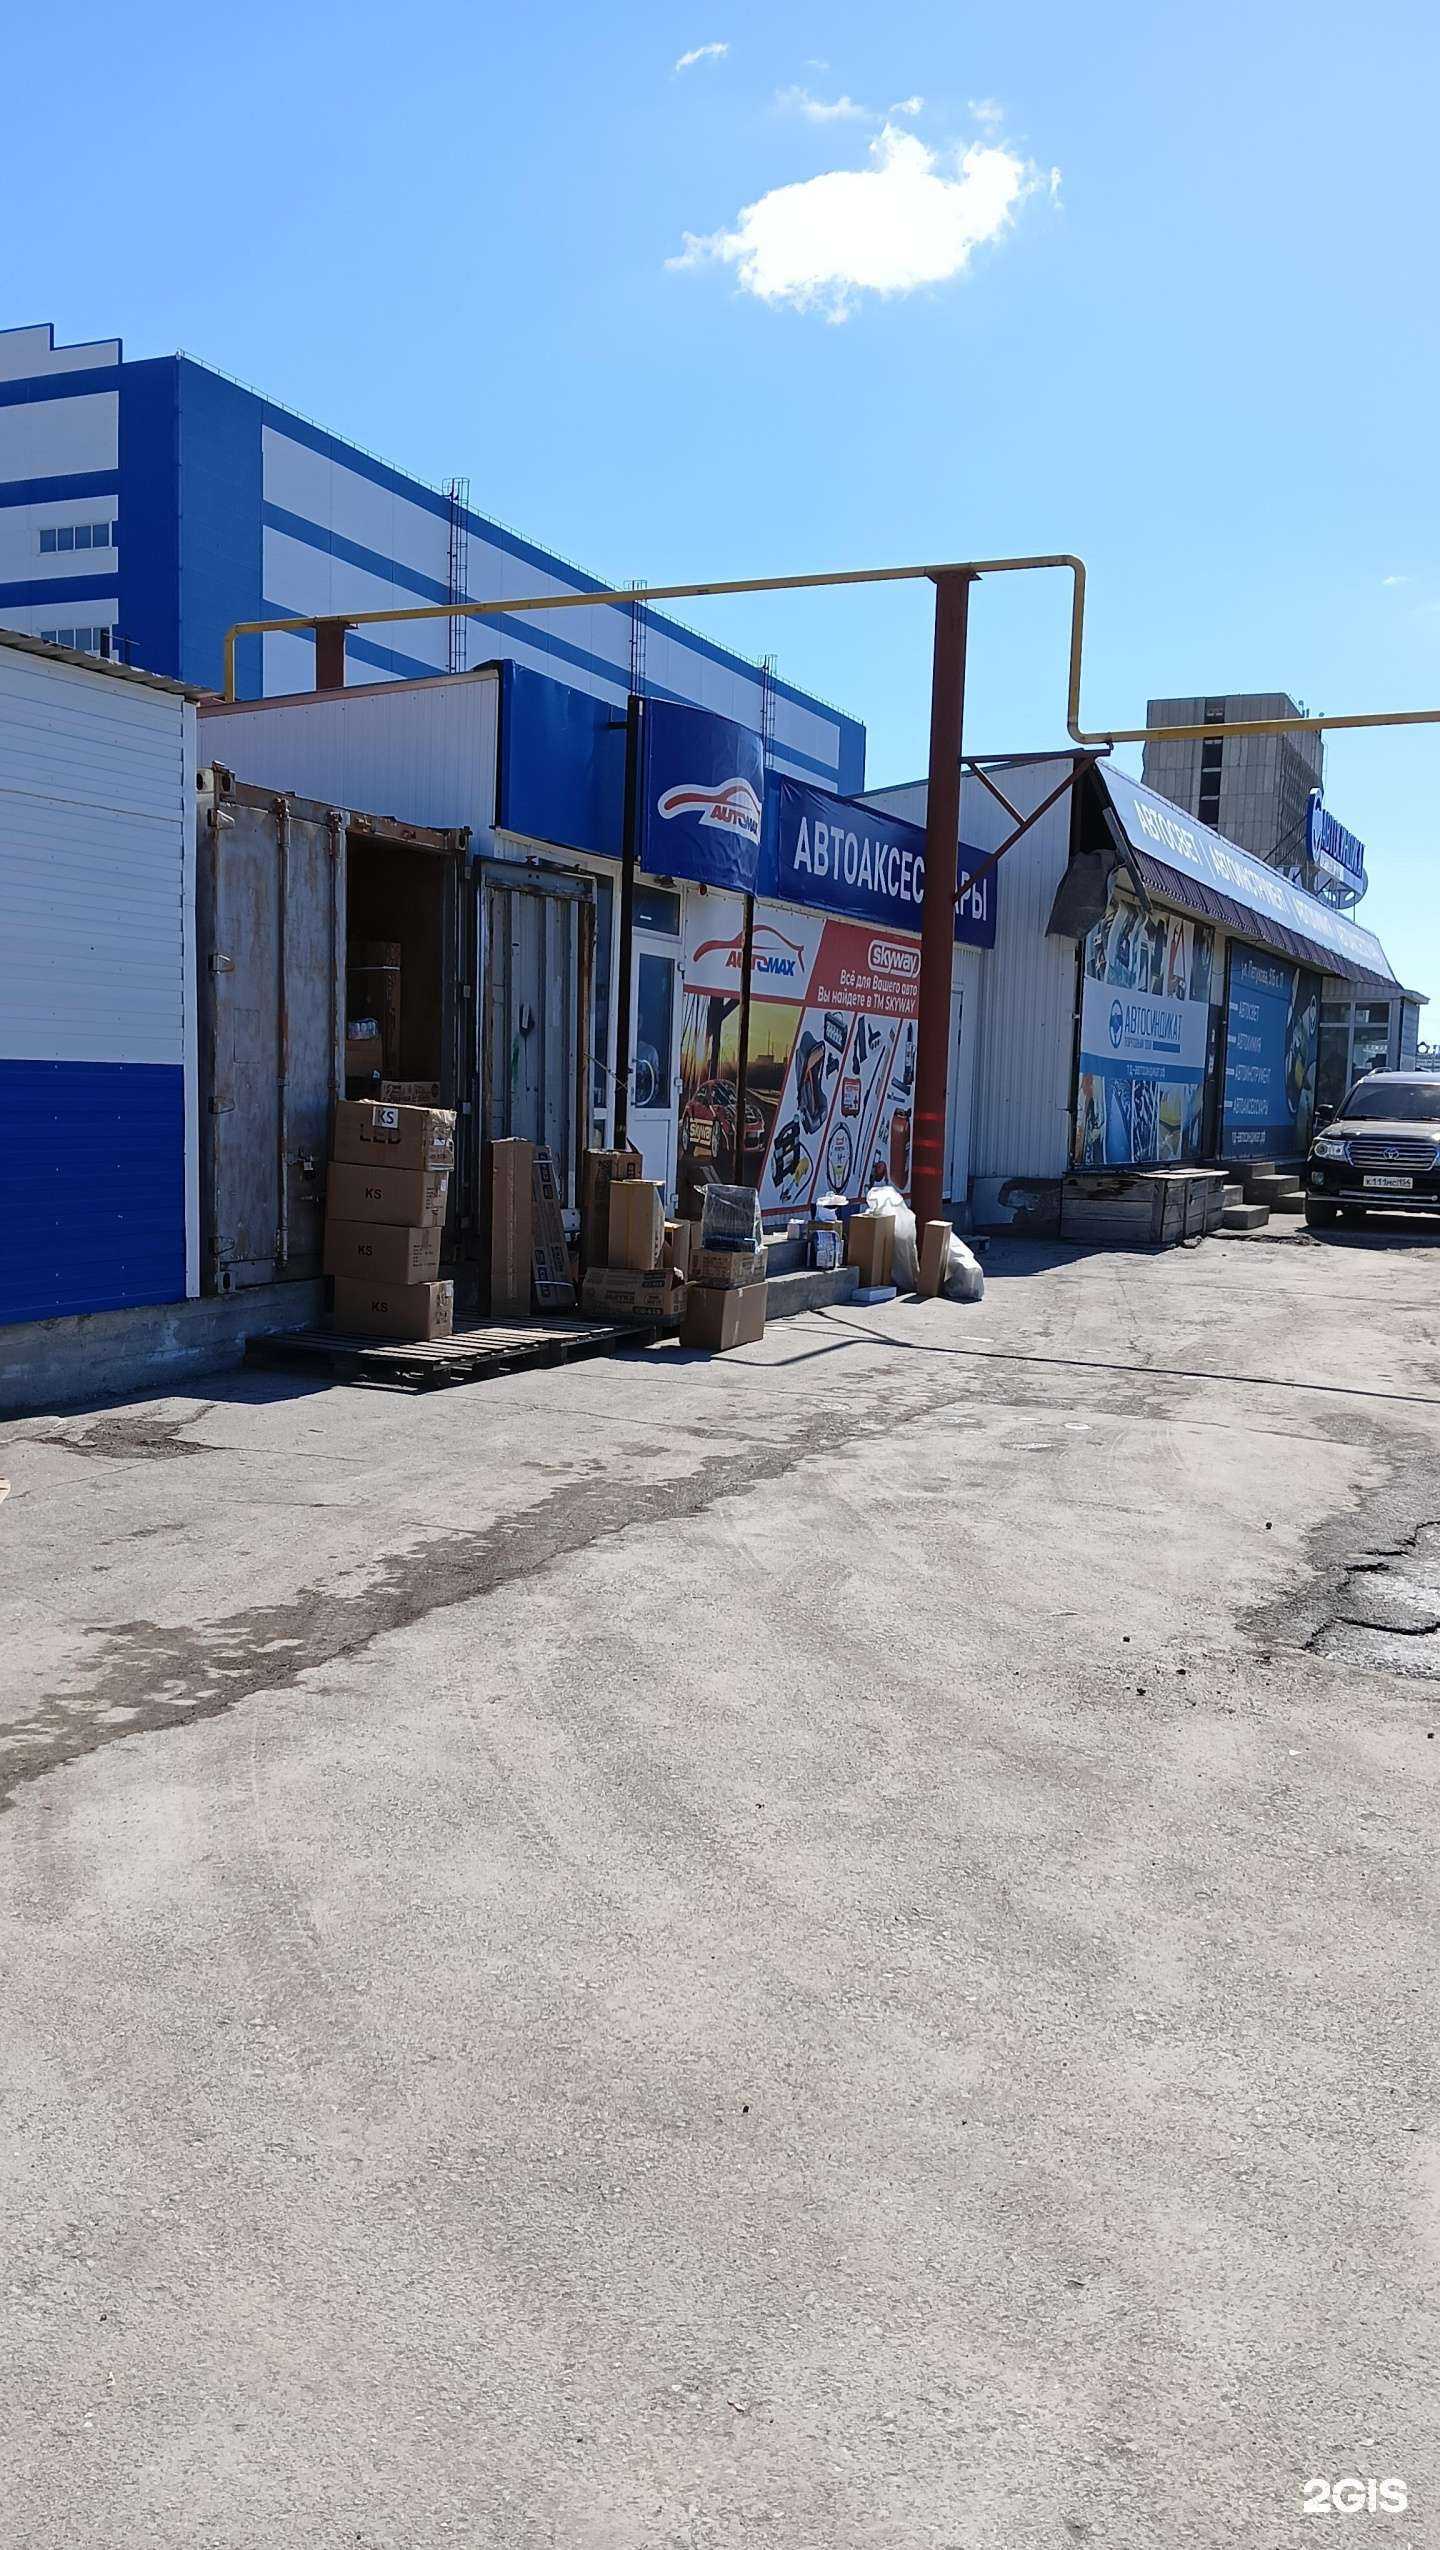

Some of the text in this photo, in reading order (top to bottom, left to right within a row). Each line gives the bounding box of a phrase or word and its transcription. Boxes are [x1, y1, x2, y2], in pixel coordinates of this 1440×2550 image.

[793, 816, 987, 921] АВТОАКСЕСРЫ
[840, 969, 856, 986] Всё
[856, 975, 871, 990] для
[901, 982, 918, 996] авто
[817, 986, 830, 1003] Вы
[831, 988, 865, 1007] найдете
[866, 995, 871, 1007] в
[885, 996, 916, 1013] SKYWAY
[1124, 1005, 1183, 1041] АВТОСИНДИКАТ
[377, 1110, 395, 1125] KS
[364, 1187, 383, 1200] KS
[357, 1245, 374, 1257] KS
[371, 1301, 389, 1313] KS
